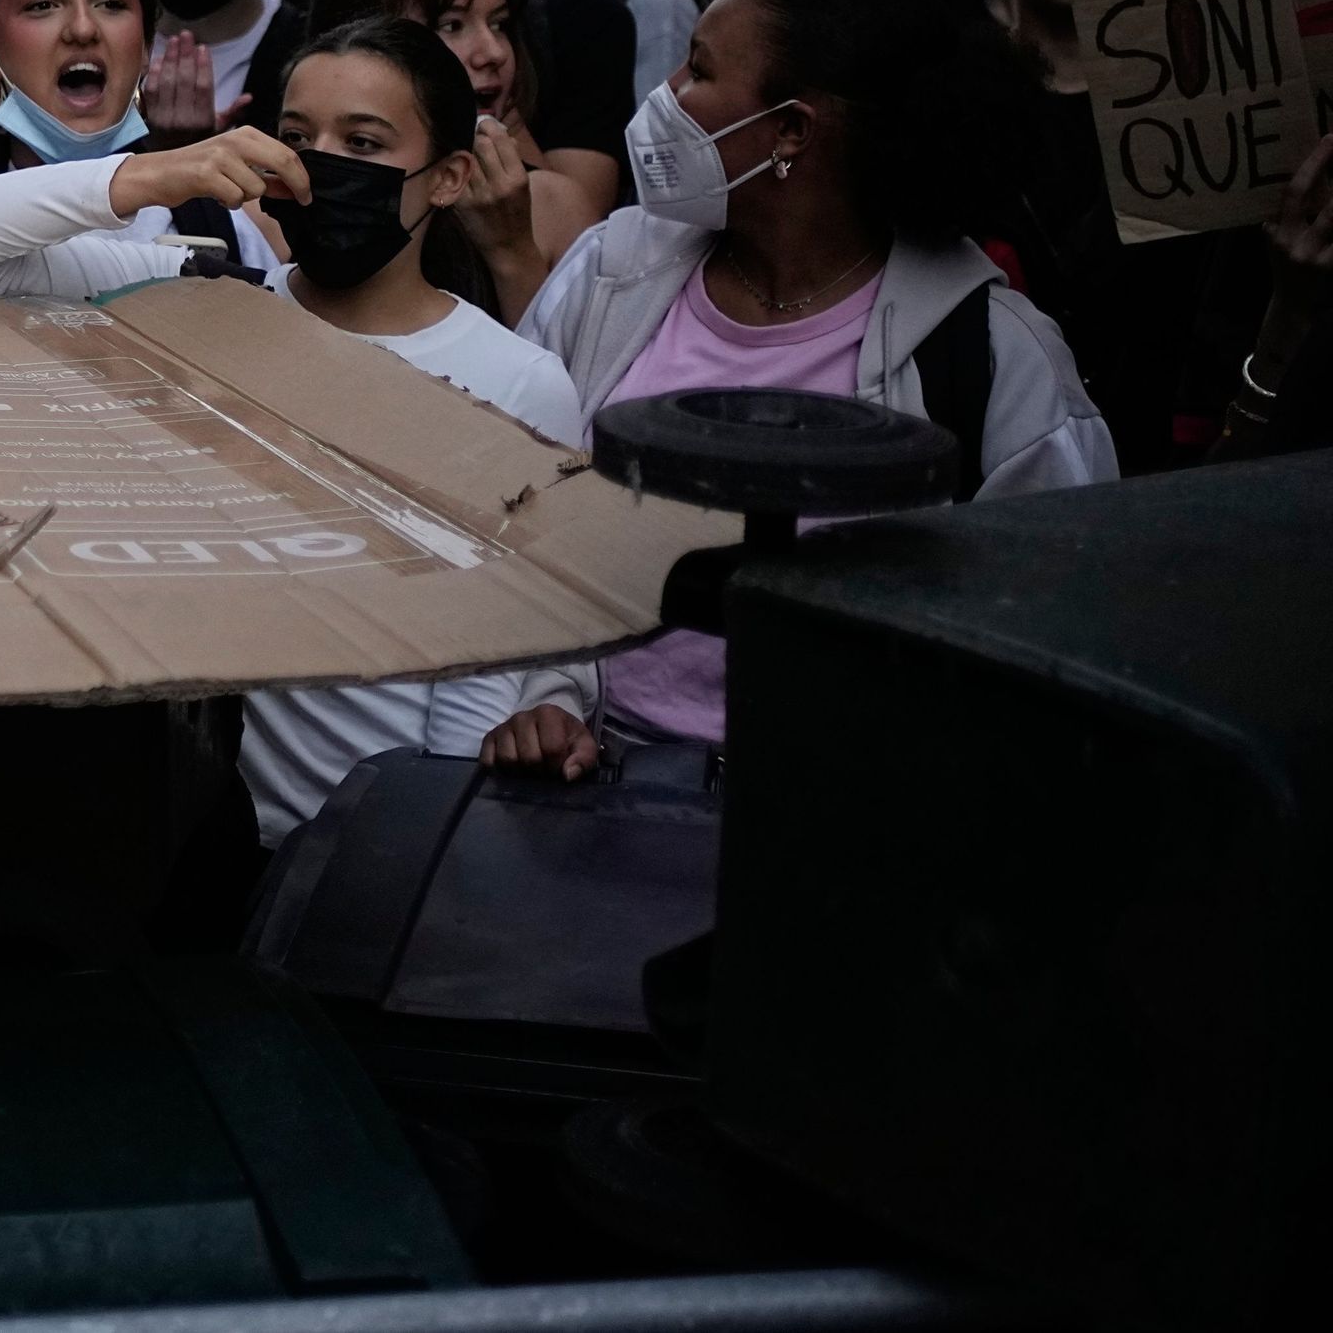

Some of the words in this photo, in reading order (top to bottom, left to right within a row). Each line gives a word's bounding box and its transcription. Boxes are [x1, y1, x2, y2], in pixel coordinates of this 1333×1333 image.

[1120, 100, 1292, 199] QUE
[42, 396, 158, 414] NETFLIX
[56, 498, 131, 507] Mode
[69, 530, 369, 565] QLED
